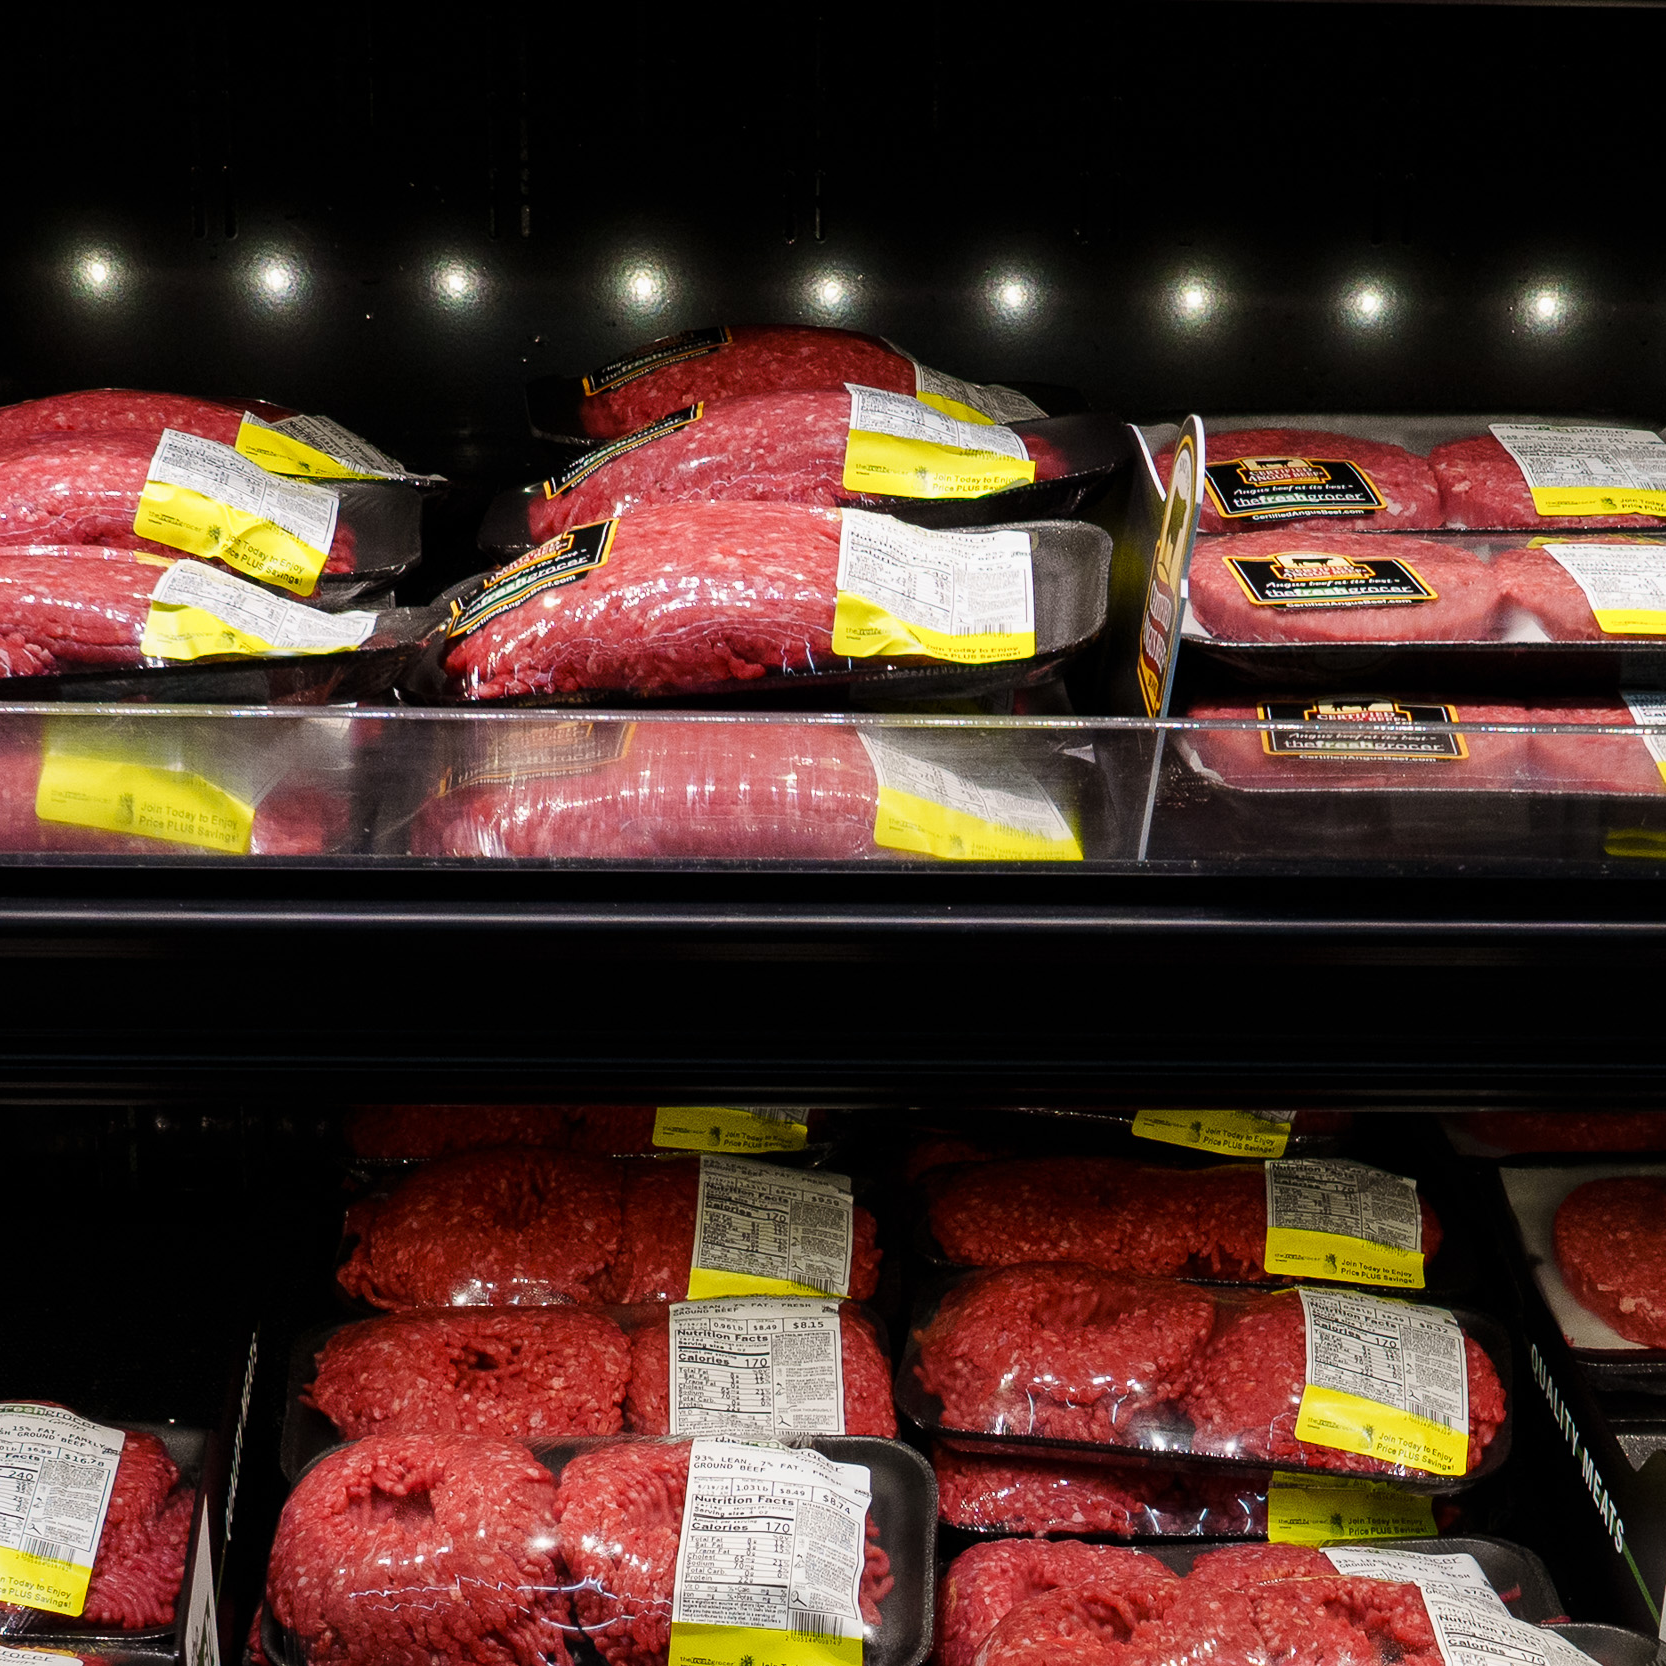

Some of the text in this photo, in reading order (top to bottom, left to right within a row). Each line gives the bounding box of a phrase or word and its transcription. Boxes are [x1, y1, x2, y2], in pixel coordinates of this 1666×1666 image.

[1233, 492, 1366, 507] thefreshgrocer
[1252, 509, 1365, 521] CertifiedAngusBeef.com
[1265, 586, 1413, 598] thefreshgrocer
[1531, 1343, 1625, 1554] QUALITY MEATS
[64, 1454, 105, 1467] $16.78
[693, 1462, 767, 1473] GROUND BEEF
[694, 1495, 794, 1506] Nutrition Facts
[736, 1484, 852, 1515] 1.03lb $8.49 $8.74
[692, 1522, 791, 1534] Calories 170
